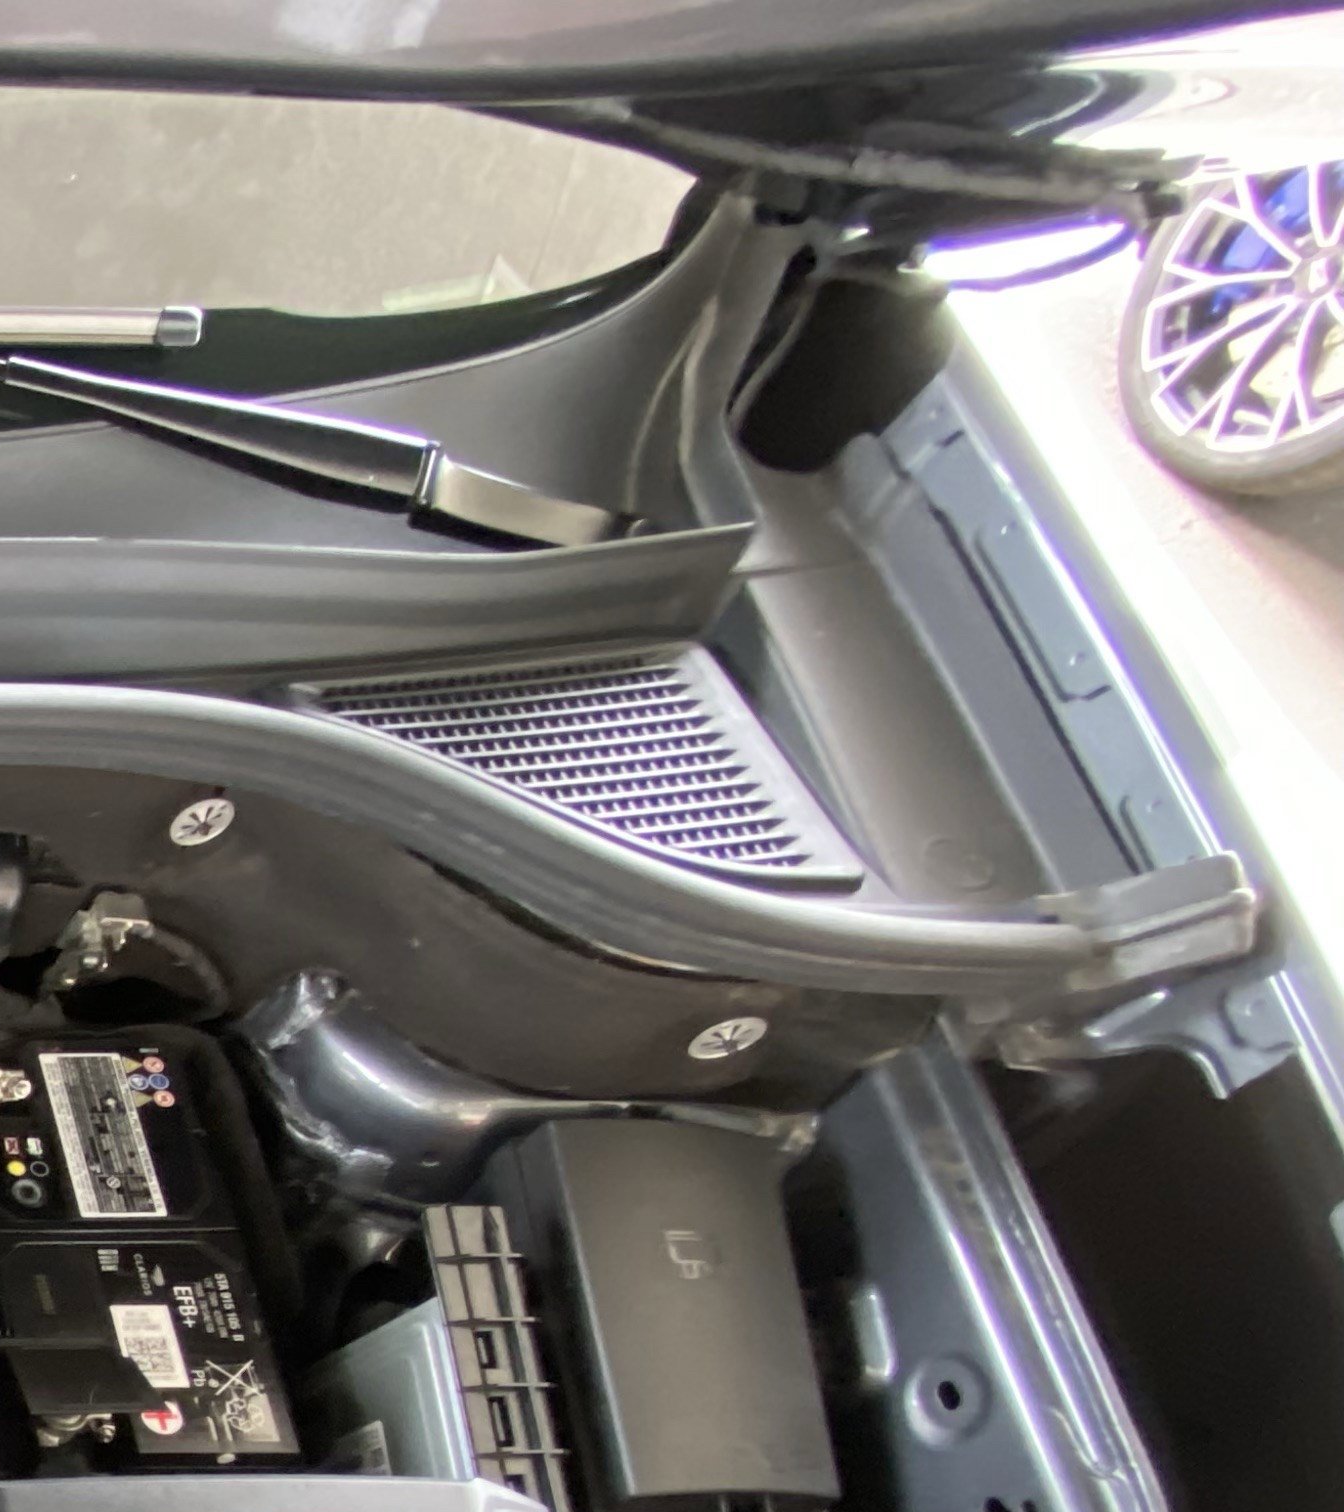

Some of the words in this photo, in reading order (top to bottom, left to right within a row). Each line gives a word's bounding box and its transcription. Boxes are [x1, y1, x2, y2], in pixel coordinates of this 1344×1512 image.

[133, 1253, 153, 1296] CLARIOS
[173, 1286, 198, 1328] EFB+
[191, 1369, 206, 1387] Pb
